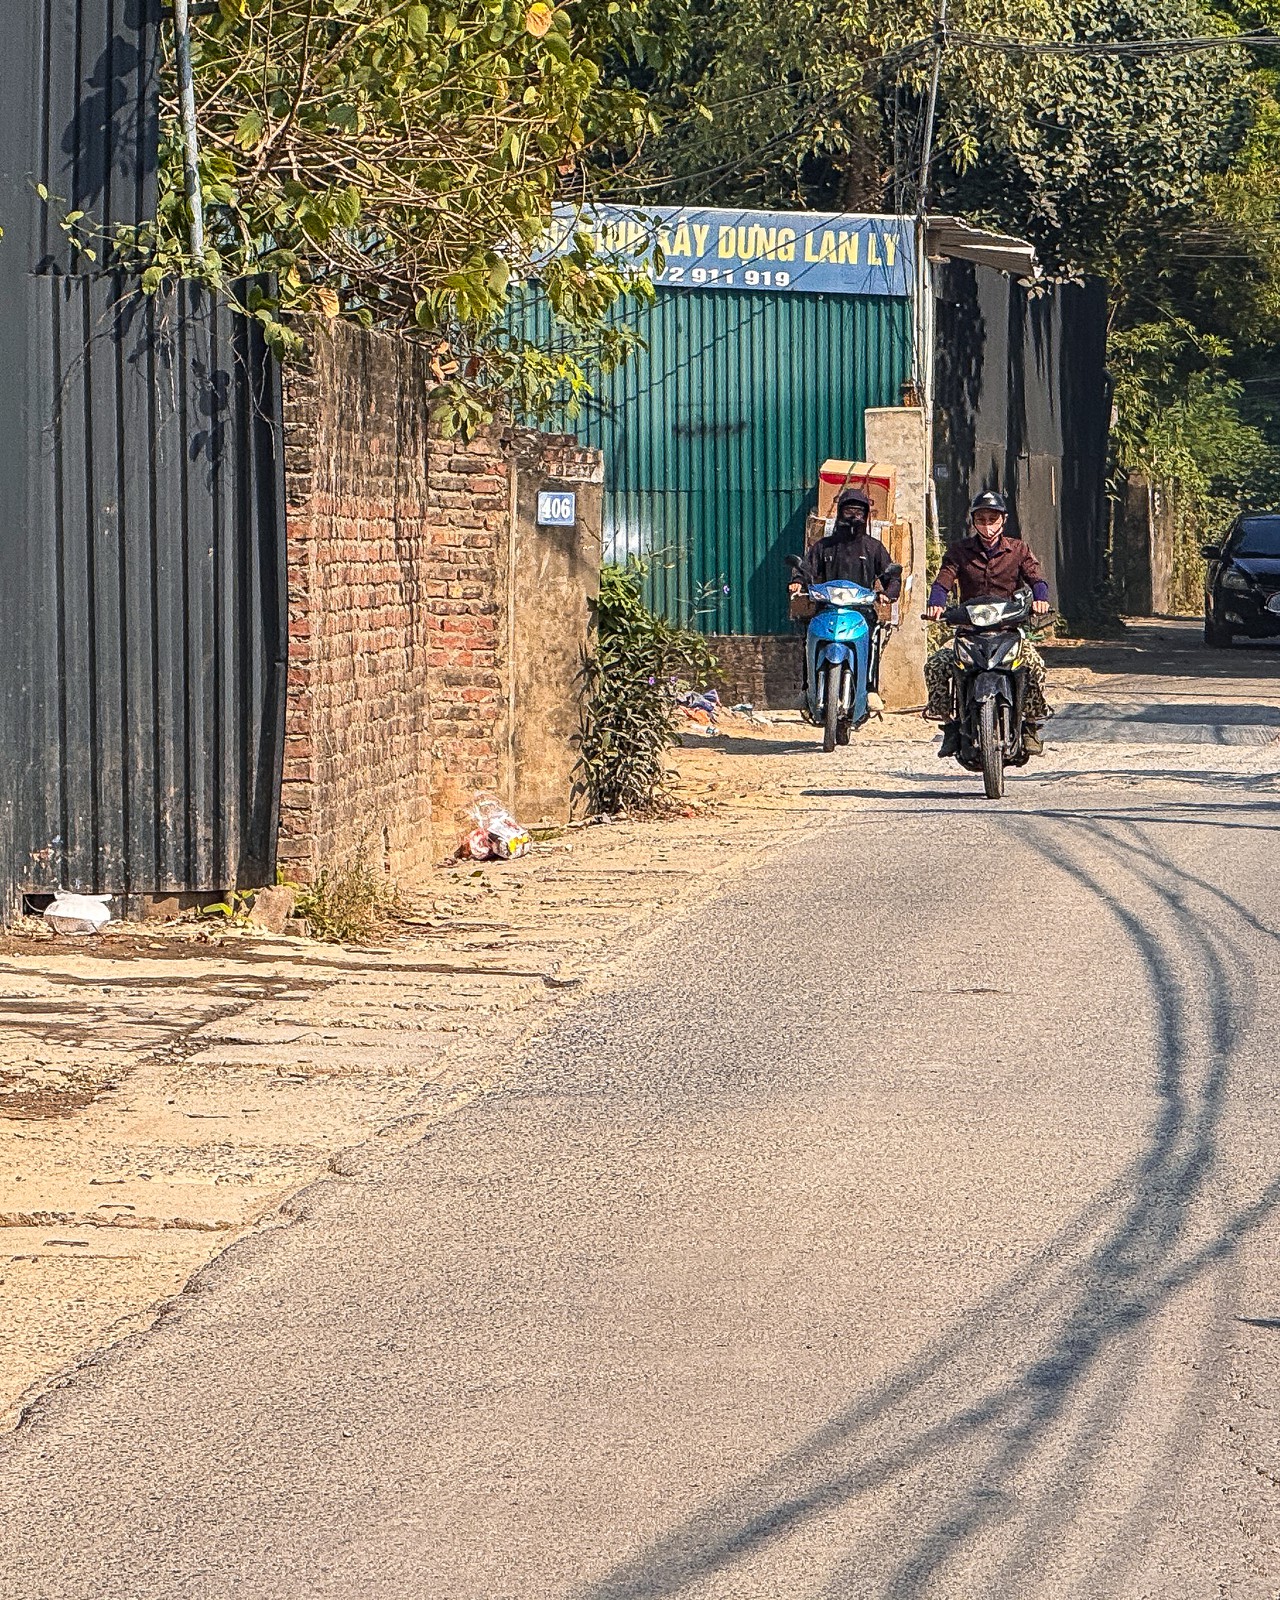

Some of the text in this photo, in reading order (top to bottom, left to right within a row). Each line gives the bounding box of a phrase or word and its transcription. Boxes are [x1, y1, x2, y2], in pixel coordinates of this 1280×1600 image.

[718, 223, 796, 267] DỰNG
[804, 229, 859, 265] LAN
[691, 268, 734, 287] 911
[744, 269, 791, 287] 919
[541, 497, 571, 519] 406
